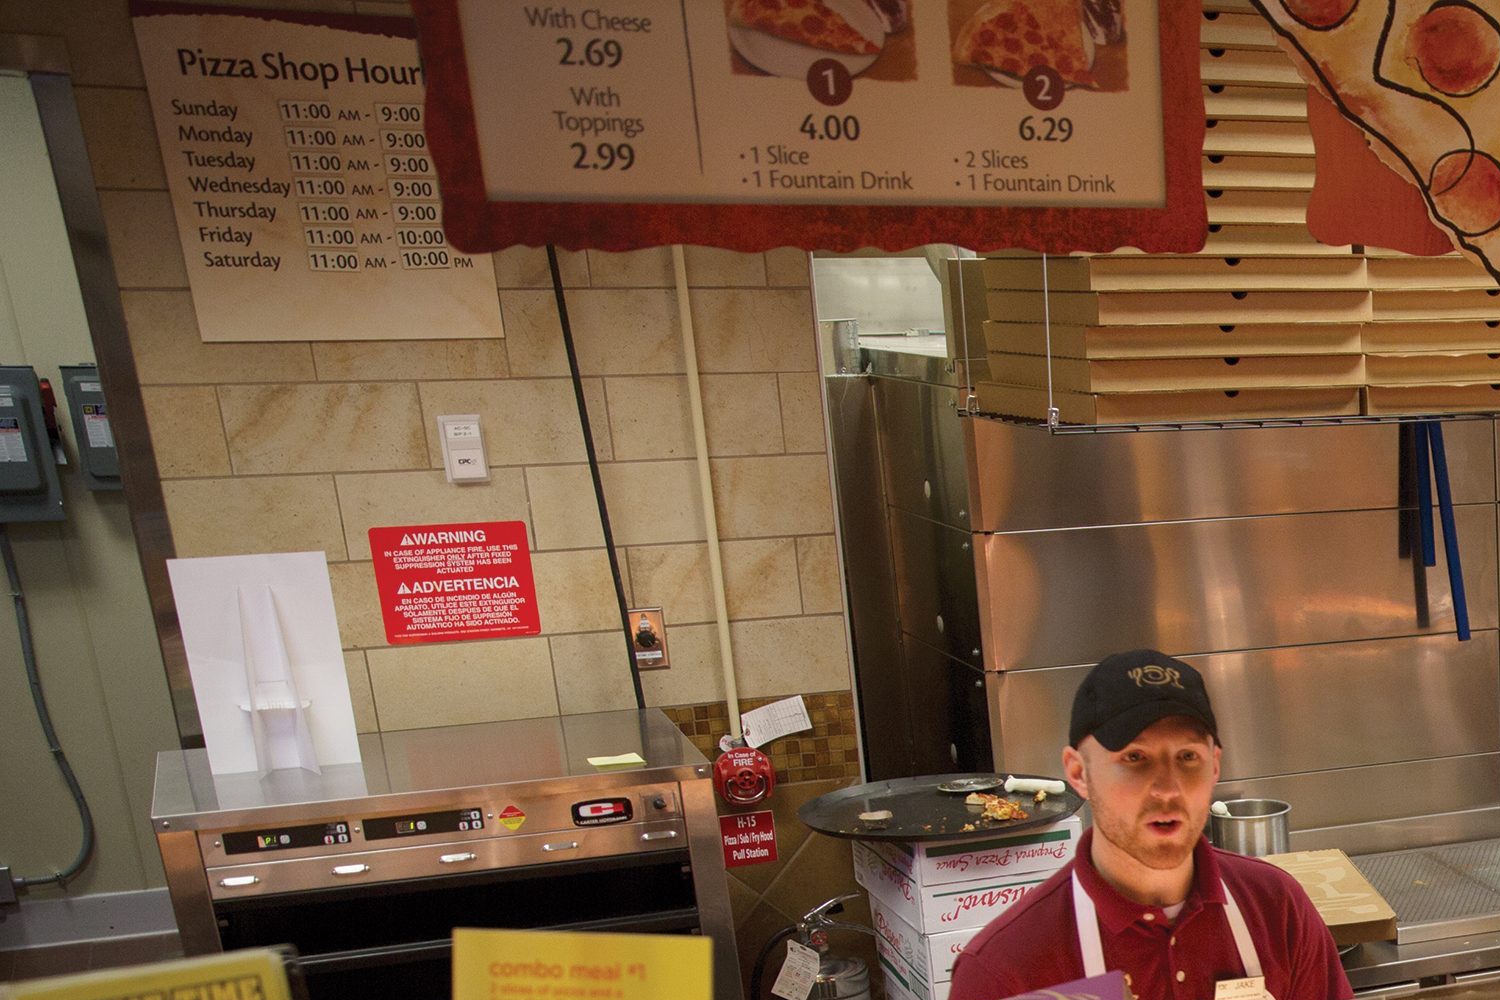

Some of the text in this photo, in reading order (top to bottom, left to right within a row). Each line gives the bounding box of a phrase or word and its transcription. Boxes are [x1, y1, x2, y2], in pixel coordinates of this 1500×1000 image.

[525, 7, 651, 32] With Cheese
[556, 38, 622, 68] 2.69
[177, 49, 422, 89] Pizza Shop Hour
[822, 69, 835, 95] 1
[1037, 75, 1052, 100] 2
[570, 87, 620, 107] With
[172, 100, 420, 122] Sunday 11:00 9:00
[552, 111, 644, 138] Toppings
[800, 114, 860, 141] 4.00
[1019, 118, 1072, 142] 6.29
[178, 126, 425, 148] Monday 11:00 9:00
[183, 151, 428, 172] Tuesday 11:00 9:00
[570, 142, 635, 170] 2.99
[768, 146, 809, 165] Slice
[982, 151, 1029, 169] Slices
[188, 177, 432, 197] Wednesday 11:00 9:00
[770, 171, 913, 191] Fountain Drink
[193, 202, 436, 221] Thursday 11:00 9:00
[199, 227, 443, 246] Friday 11:00 10:00
[204, 252, 473, 271] Saturday 11:00 AM 10:00 PM
[413, 530, 486, 545] WARNING
[393, 555, 445, 563] EXTINGUISHER
[426, 547, 466, 555] APPLIANCE
[413, 576, 519, 593] ADVERTENCIA
[738, 816, 756, 828] H-15
[724, 830, 773, 845] Pizza Sub Fry Hood
[733, 848, 768, 860] Pull Station
[936, 841, 1068, 872] Prepared Pizza Sauce
[490, 962, 621, 981] combo meal
